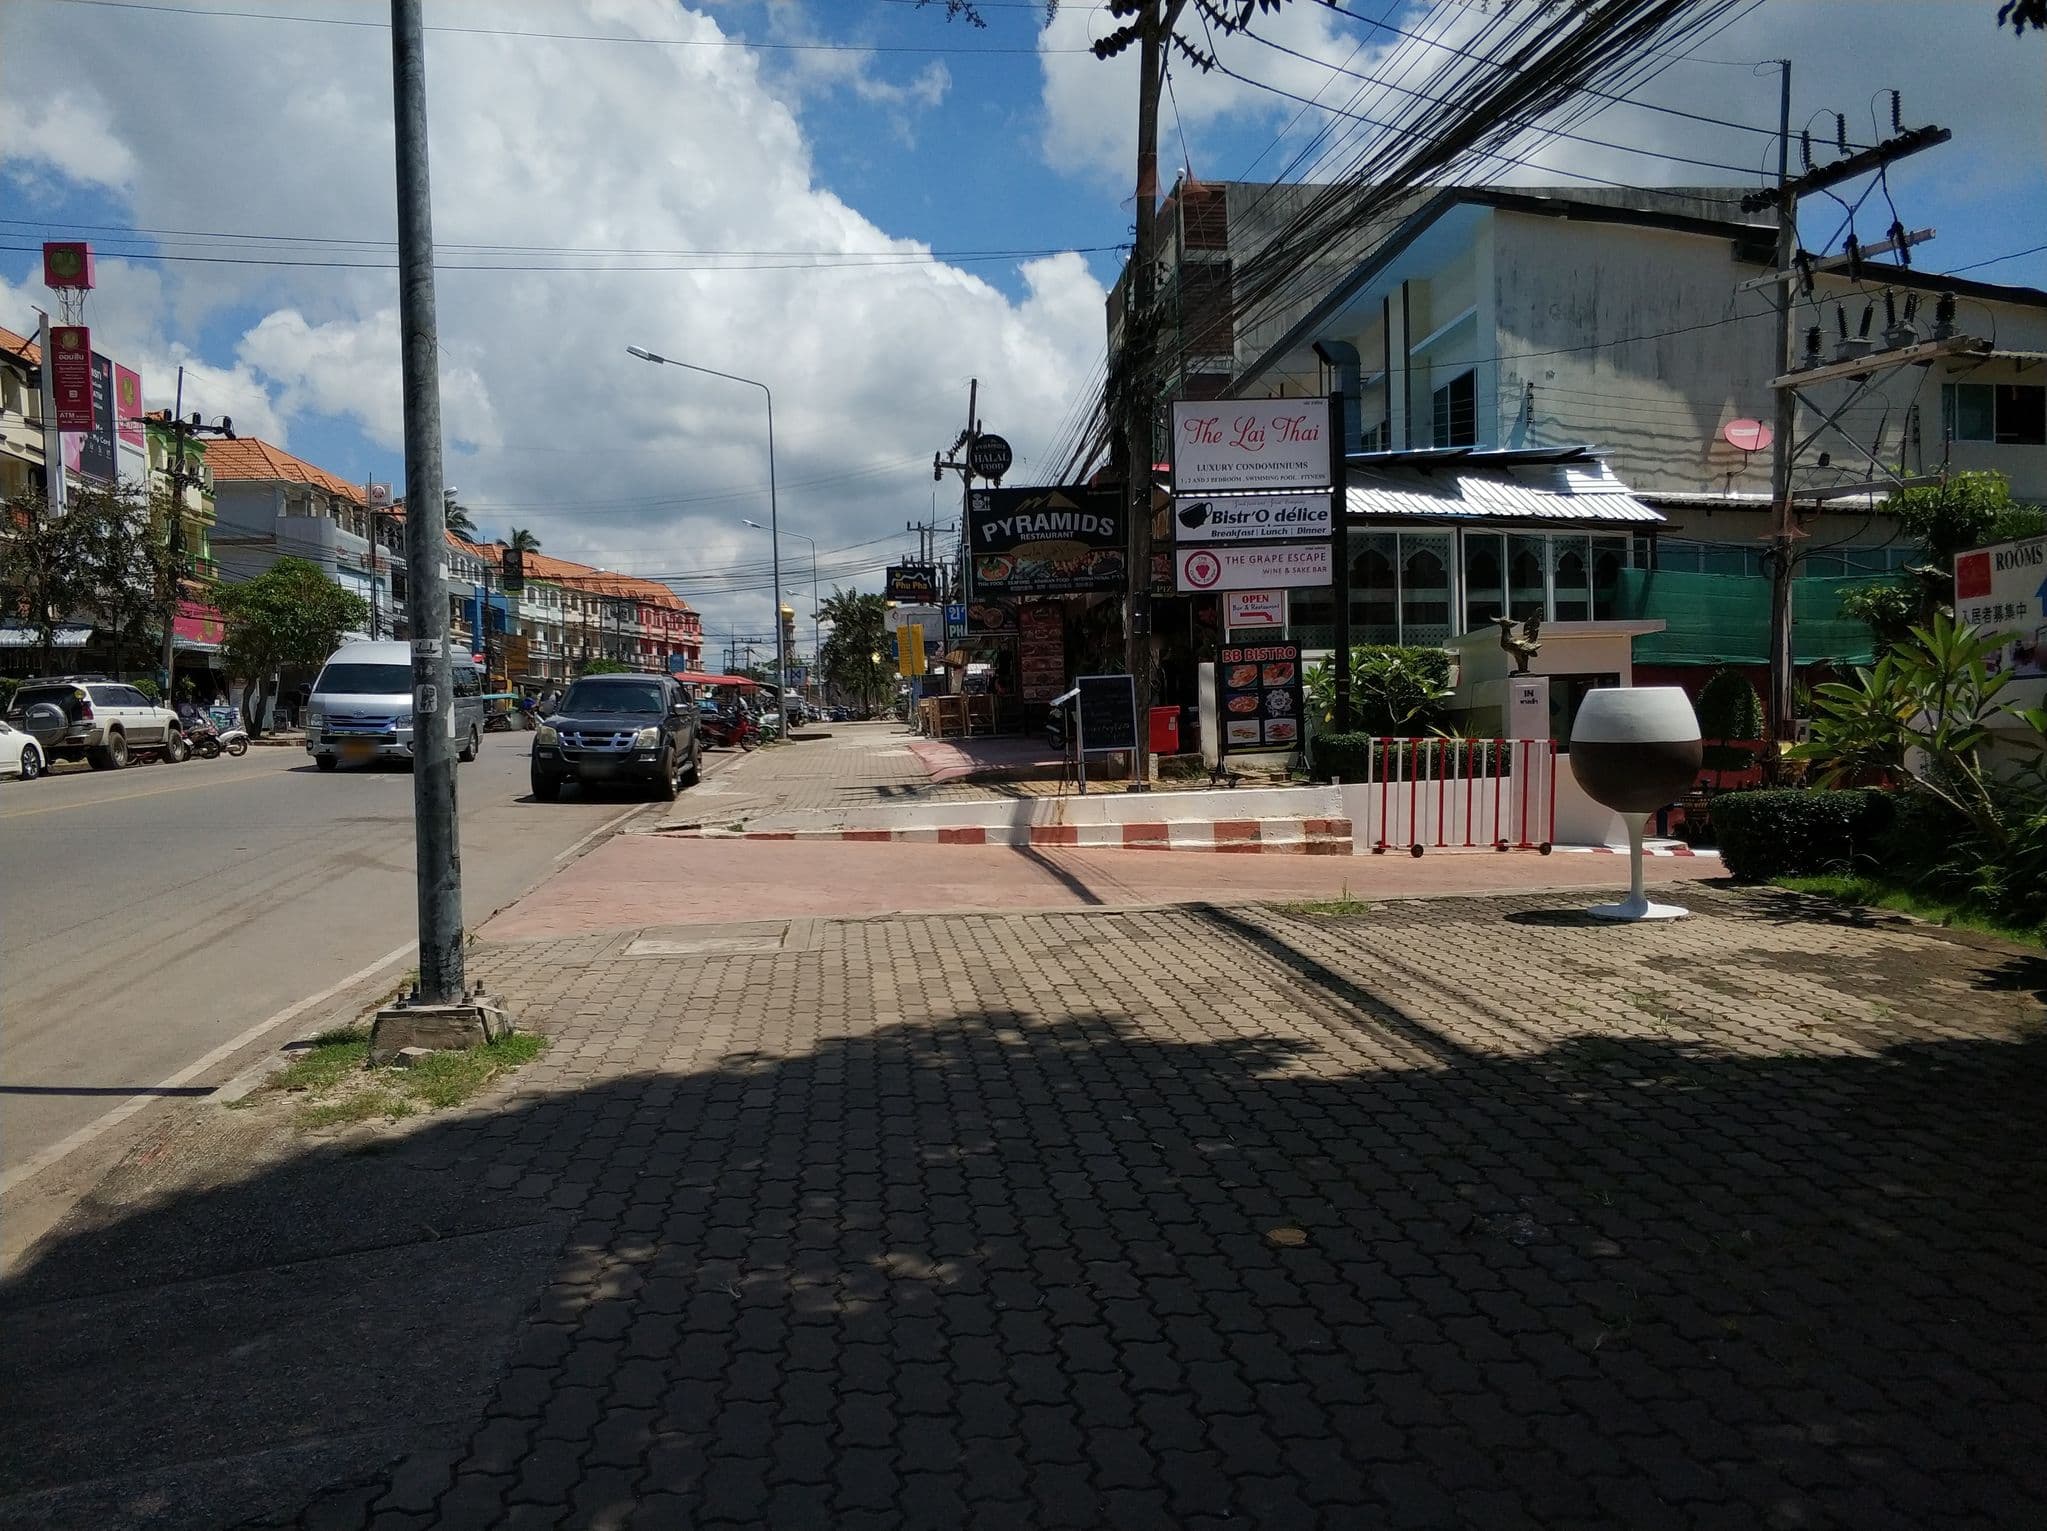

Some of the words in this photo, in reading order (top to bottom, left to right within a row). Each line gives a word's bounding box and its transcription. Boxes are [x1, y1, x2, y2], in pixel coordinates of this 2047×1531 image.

[1184, 417, 1222, 445] The
[1229, 416, 1266, 451] Lai
[1272, 415, 1320, 443] Thai
[974, 453, 1010, 463] HALAL
[981, 463, 1004, 471] FOOD
[1197, 463, 1234, 472] LUXURY
[1236, 461, 1309, 471] CONDOMINIUMS
[1274, 506, 1328, 523] délice
[981, 512, 1115, 543] PYRAMIDS
[1211, 528, 1255, 538] Breakfast
[1261, 528, 1288, 536] Lunch
[1297, 526, 1327, 535] Dinner
[1020, 530, 1074, 541] RESTAURANT
[1225, 555, 1246, 566] THE
[1249, 553, 1284, 564] GRAPE
[1287, 552, 1326, 563] ESCAPE
[1995, 544, 2044, 572] ROOMS
[1263, 567, 1283, 575] WINE
[895, 581, 911, 590] Phu
[912, 581, 928, 590] Pha
[1242, 594, 1269, 604] OPEN
[1962, 601, 2027, 625] 入居者募集中
[1222, 649, 1242, 663] BB
[1244, 646, 1297, 662] BISTRO
[1524, 689, 1534, 697] IN
